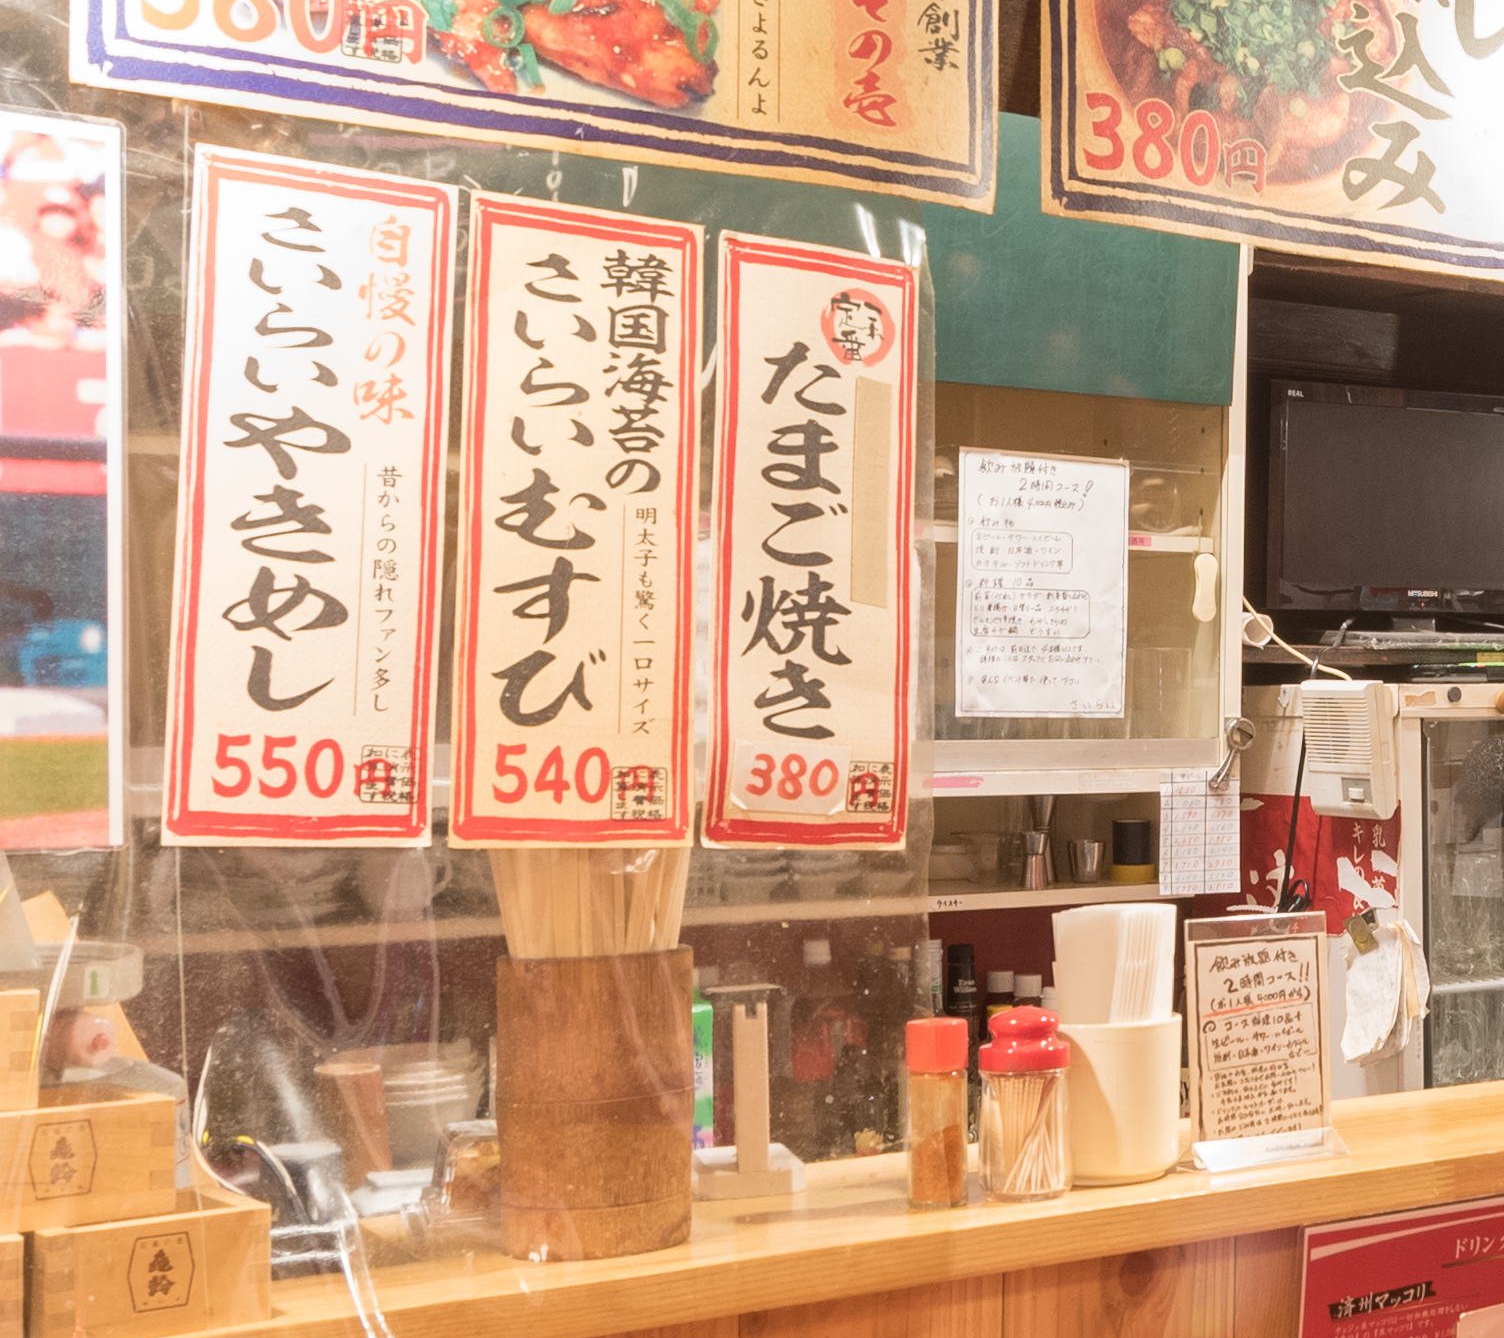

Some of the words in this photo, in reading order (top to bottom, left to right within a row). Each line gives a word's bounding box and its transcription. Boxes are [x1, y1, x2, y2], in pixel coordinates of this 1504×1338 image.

[1083, 92, 1268, 195] 380円
[351, 214, 418, 426] 自慢の味
[600, 250, 673, 495] 韓国海苔の
[224, 205, 351, 714] さいらいやきめし
[491, 252, 604, 729] さいらいむすび
[742, 340, 853, 741] たまご焼き
[370, 465, 398, 712] 昔からの隠れファン多し
[633, 506, 657, 735] 明太子も驚く一口サイズ
[1337, 1283, 1427, 1318] 済州マッコリ
